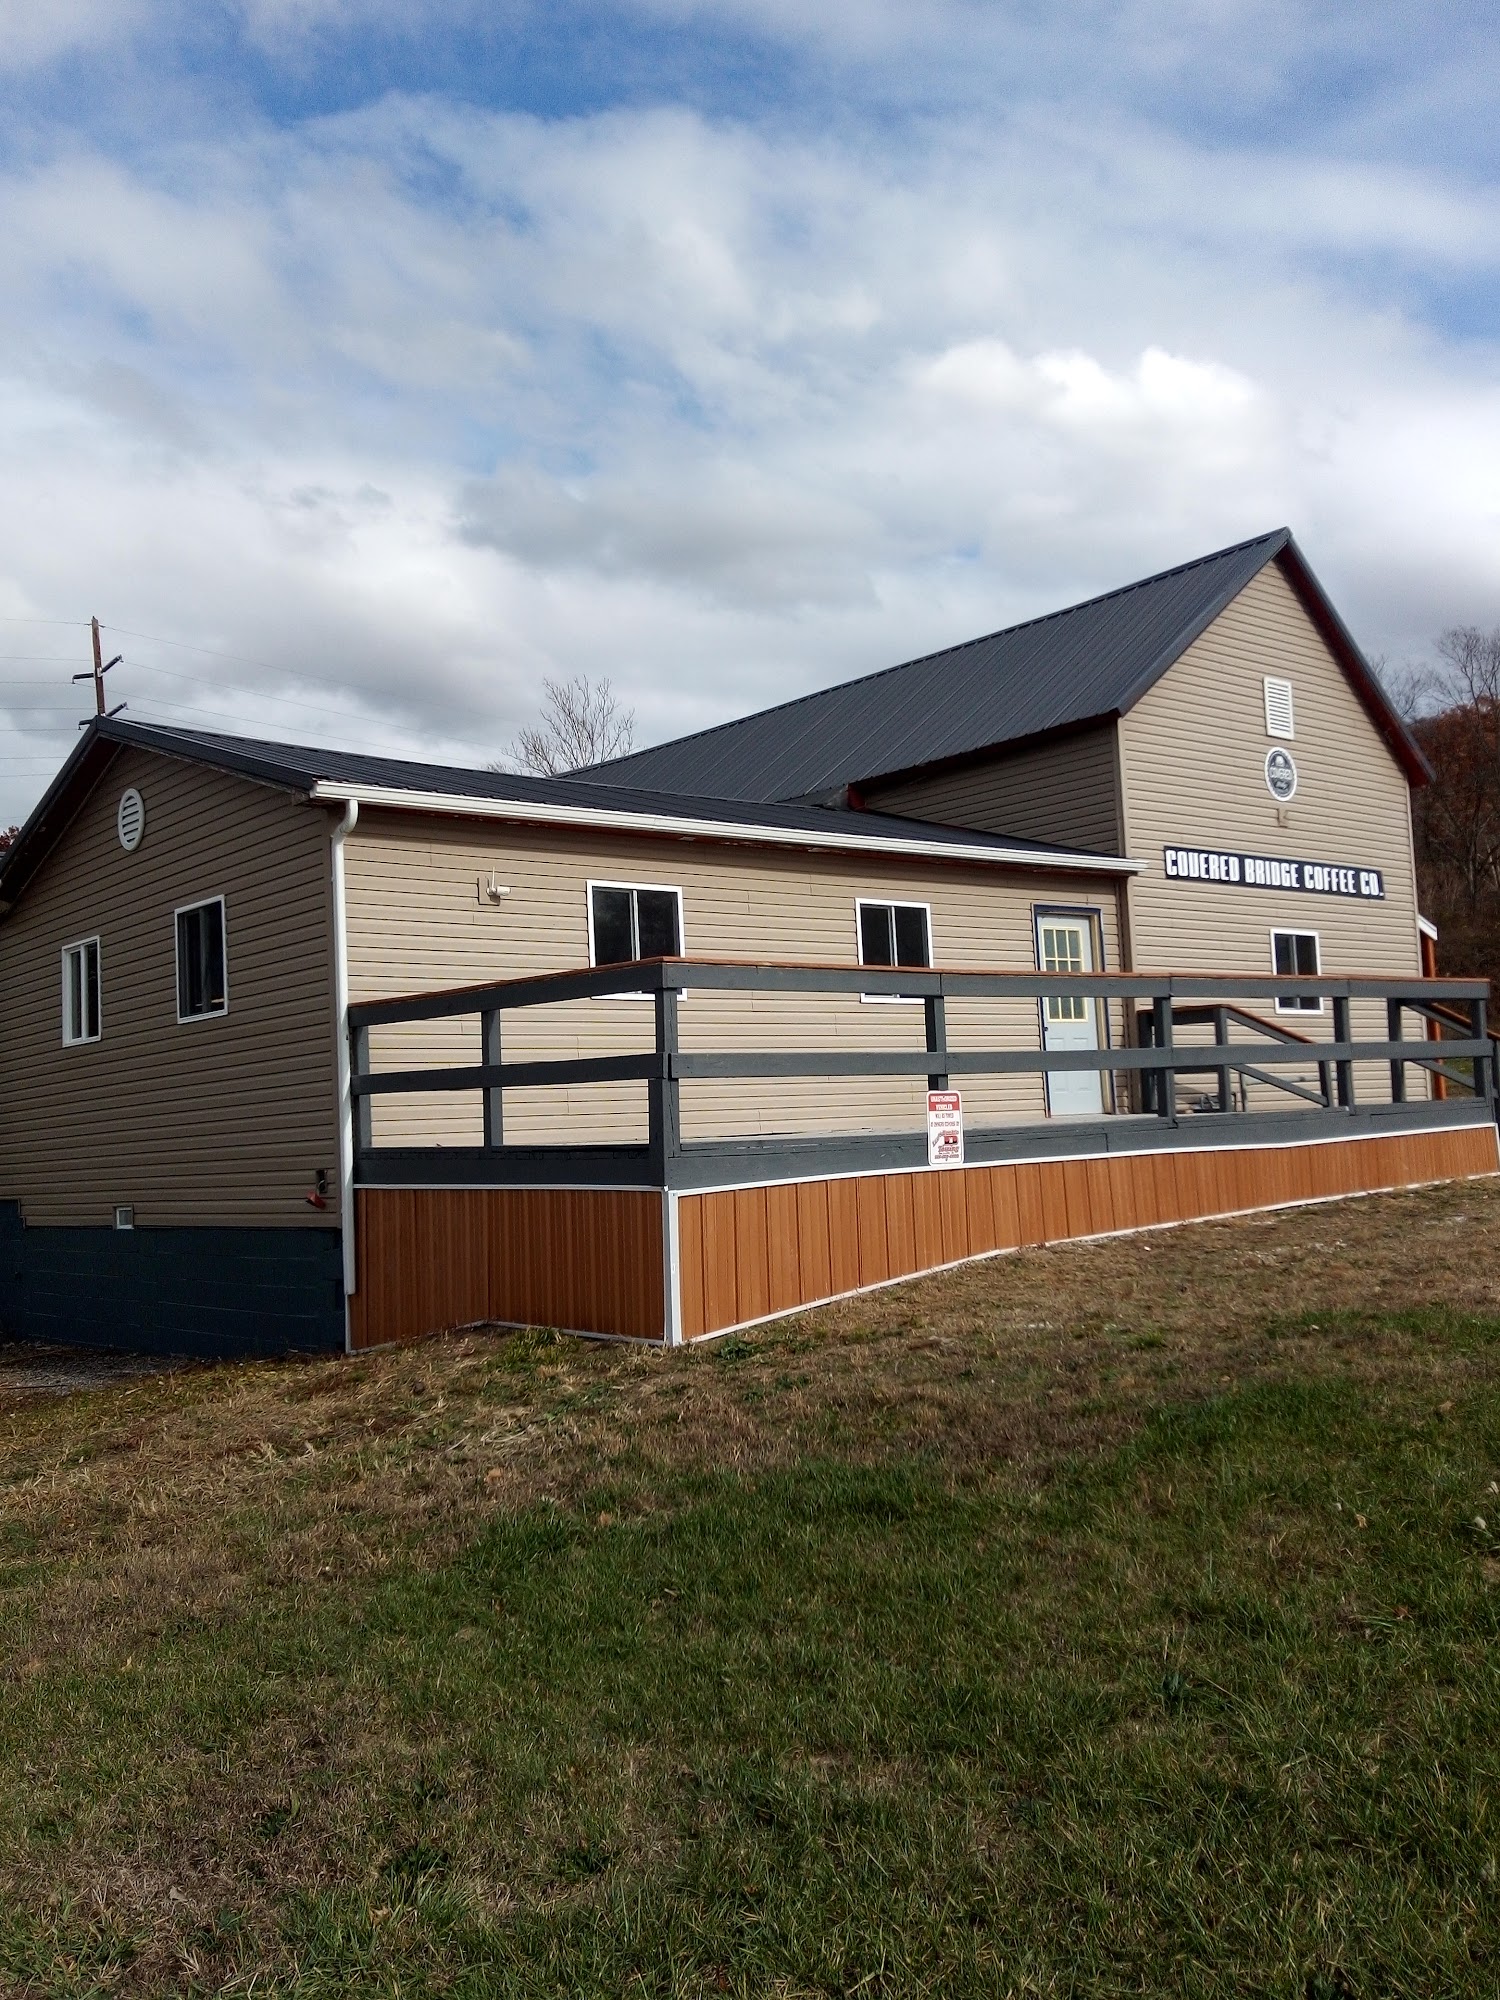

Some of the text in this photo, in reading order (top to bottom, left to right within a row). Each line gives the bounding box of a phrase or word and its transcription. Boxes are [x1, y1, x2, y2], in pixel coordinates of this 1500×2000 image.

[1165, 849, 1384, 896] COVERED BRIDGE COFFEE CO.
